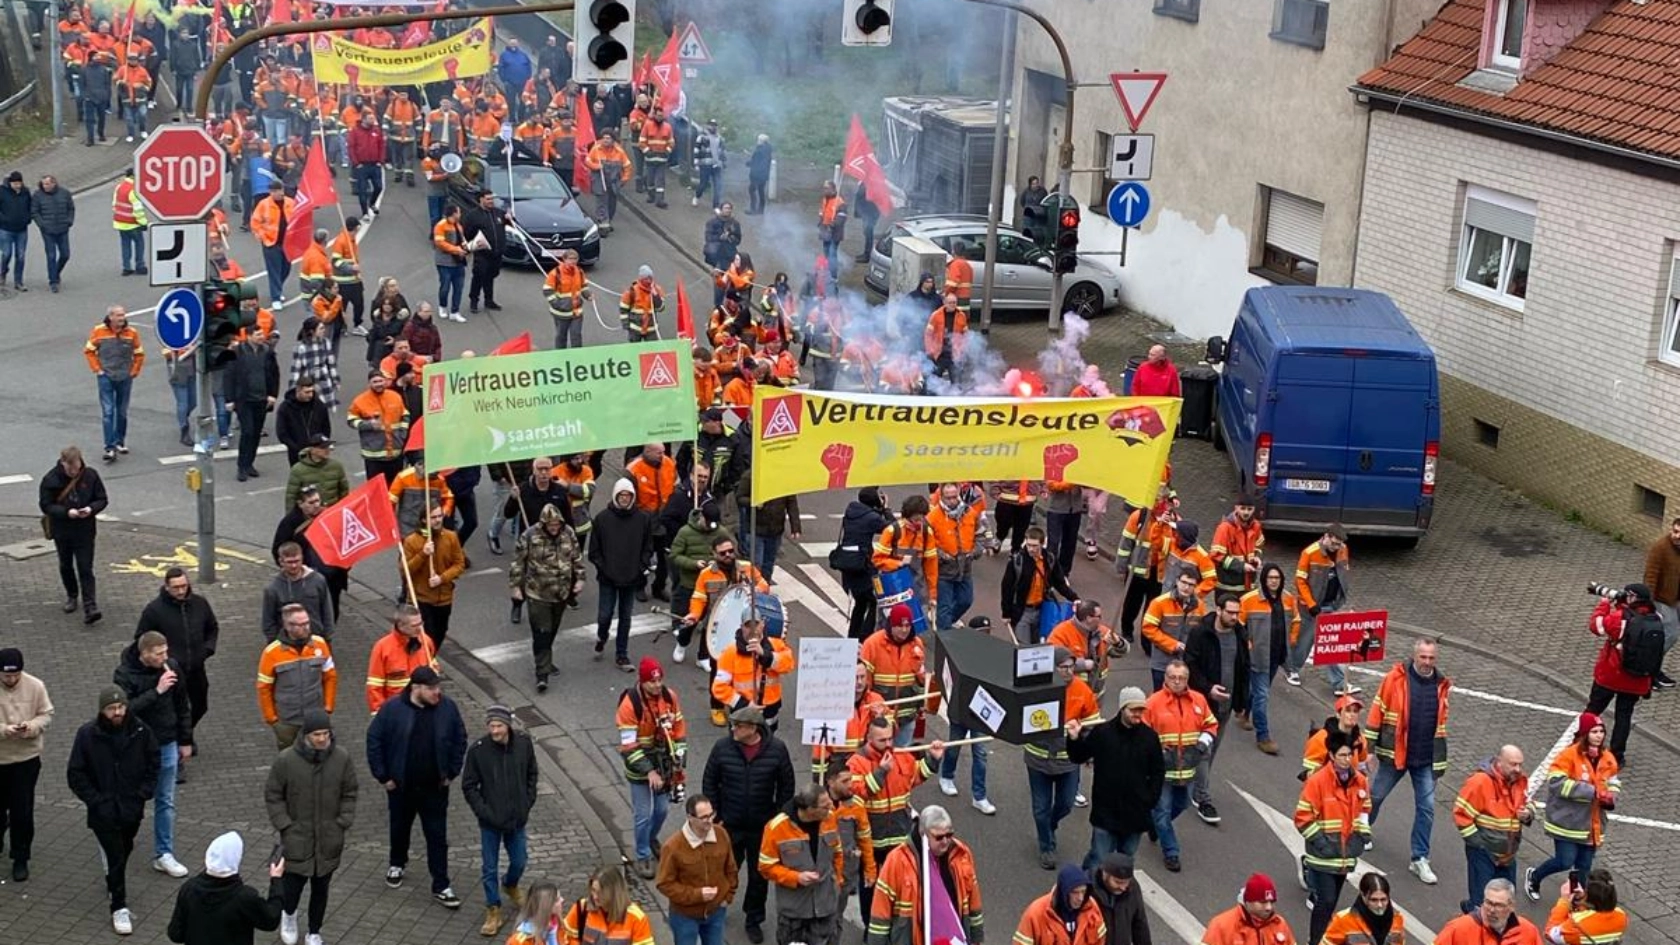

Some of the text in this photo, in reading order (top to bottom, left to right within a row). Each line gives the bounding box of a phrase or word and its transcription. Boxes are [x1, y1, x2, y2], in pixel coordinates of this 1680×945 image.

[334, 43, 462, 66] Vertrauensleute
[145, 155, 216, 192] STOP
[449, 358, 632, 395] Vertrauensleute
[473, 390, 592, 413] Werk Neunkirchen
[806, 398, 1100, 431] Vertrauensleute
[507, 419, 582, 443] saarstahl
[904, 441, 1020, 458] saarstahl
[1318, 634, 1339, 643] ZUM
[1320, 623, 1341, 632] VOM
